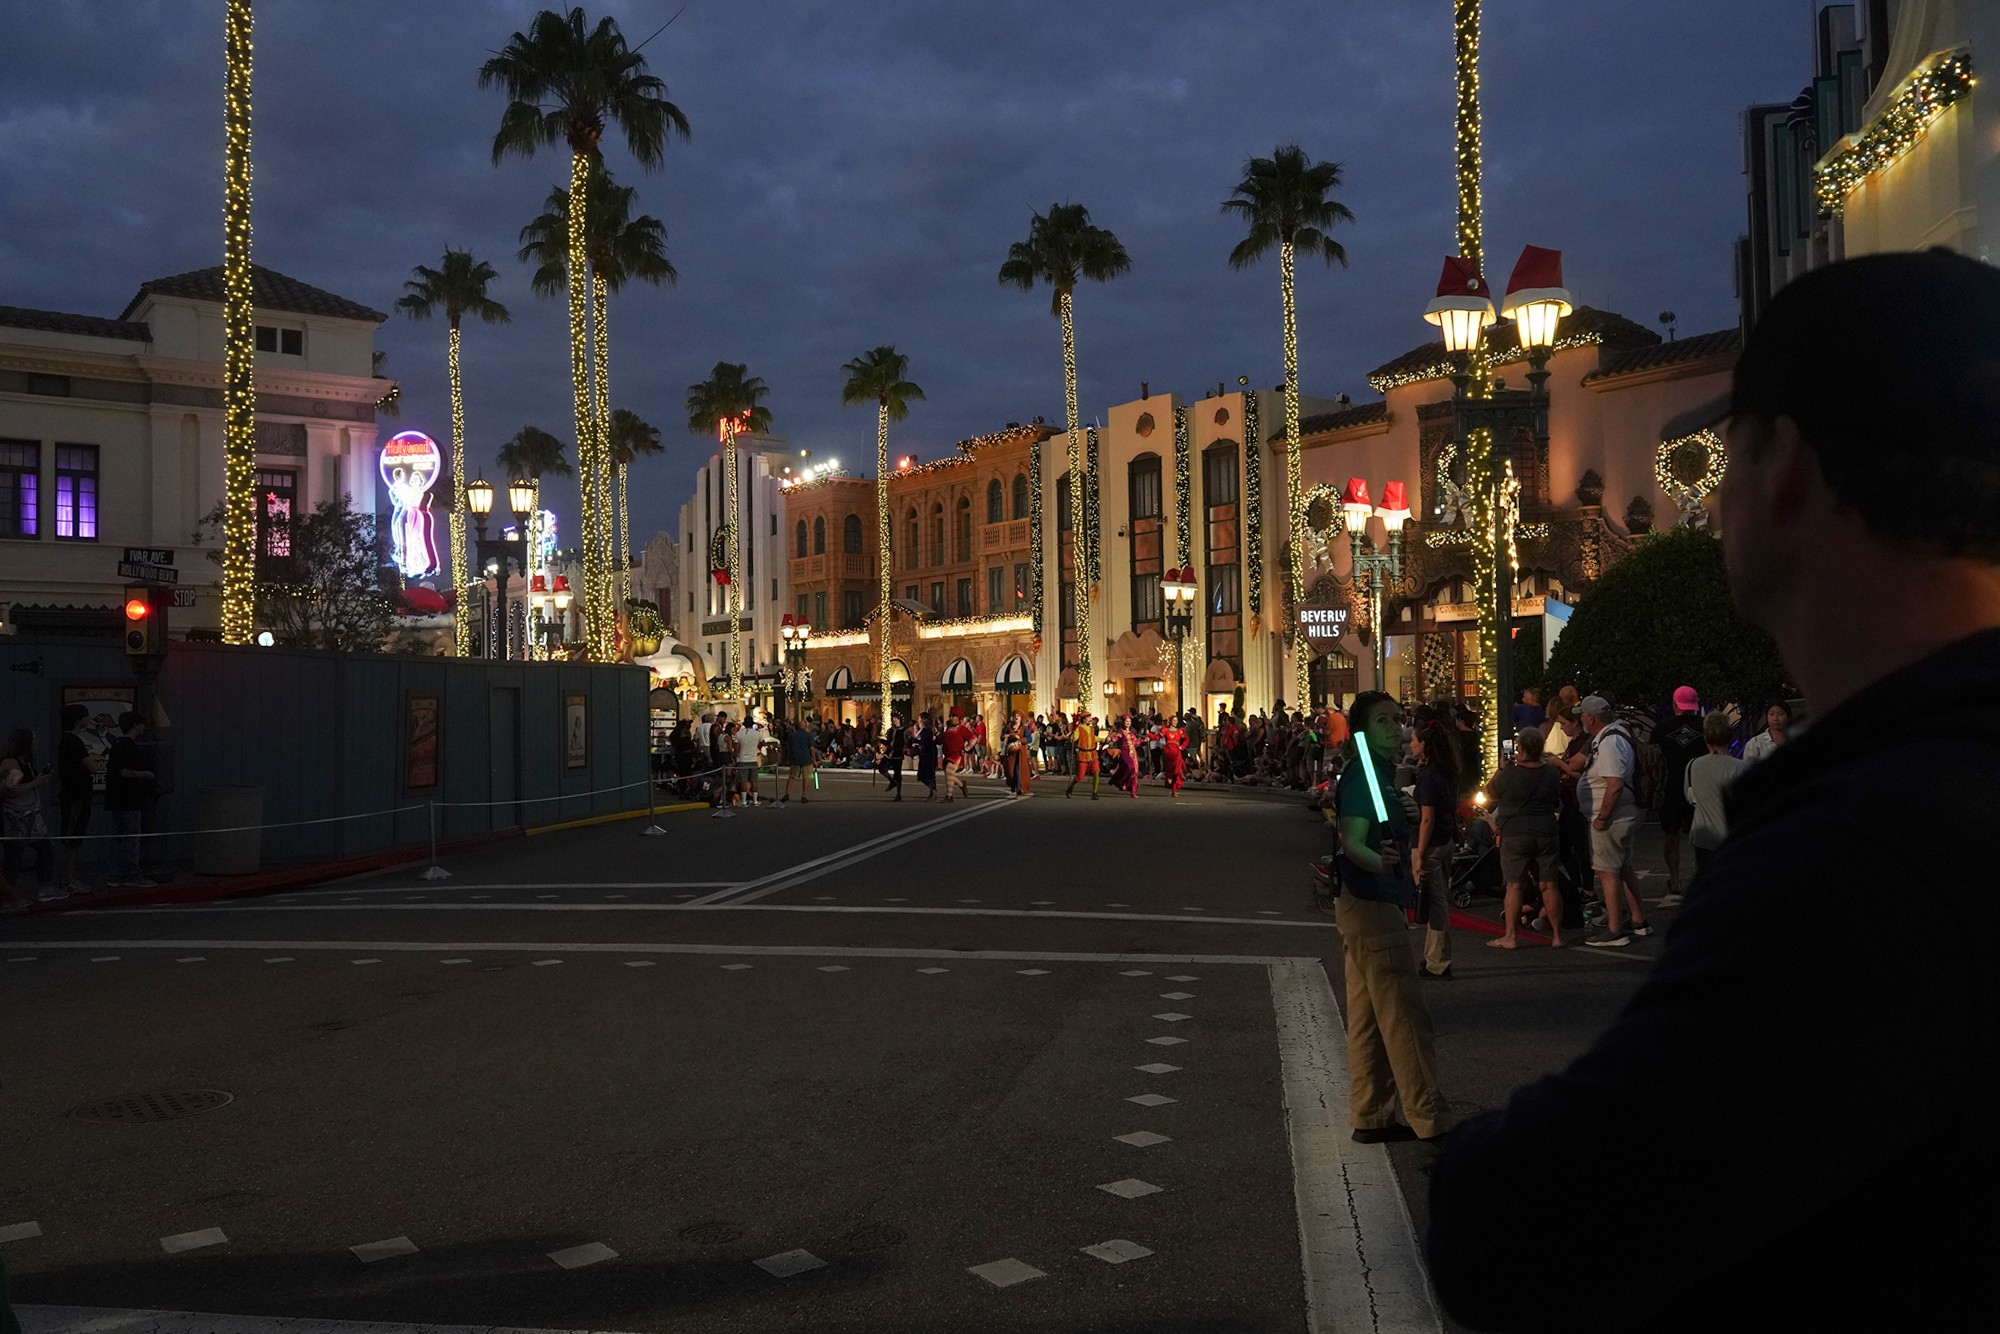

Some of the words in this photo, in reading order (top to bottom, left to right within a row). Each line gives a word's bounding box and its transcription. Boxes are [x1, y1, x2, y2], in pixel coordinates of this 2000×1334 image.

[385, 438, 431, 457] Hollywood
[129, 549, 148, 562] IVAR
[150, 551, 167, 564] AVE.
[121, 562, 158, 580] HOLLYWOOD
[174, 590, 195, 606] STOP
[1300, 609, 1346, 623] BEVERLY
[1308, 624, 1340, 638] HILLS
